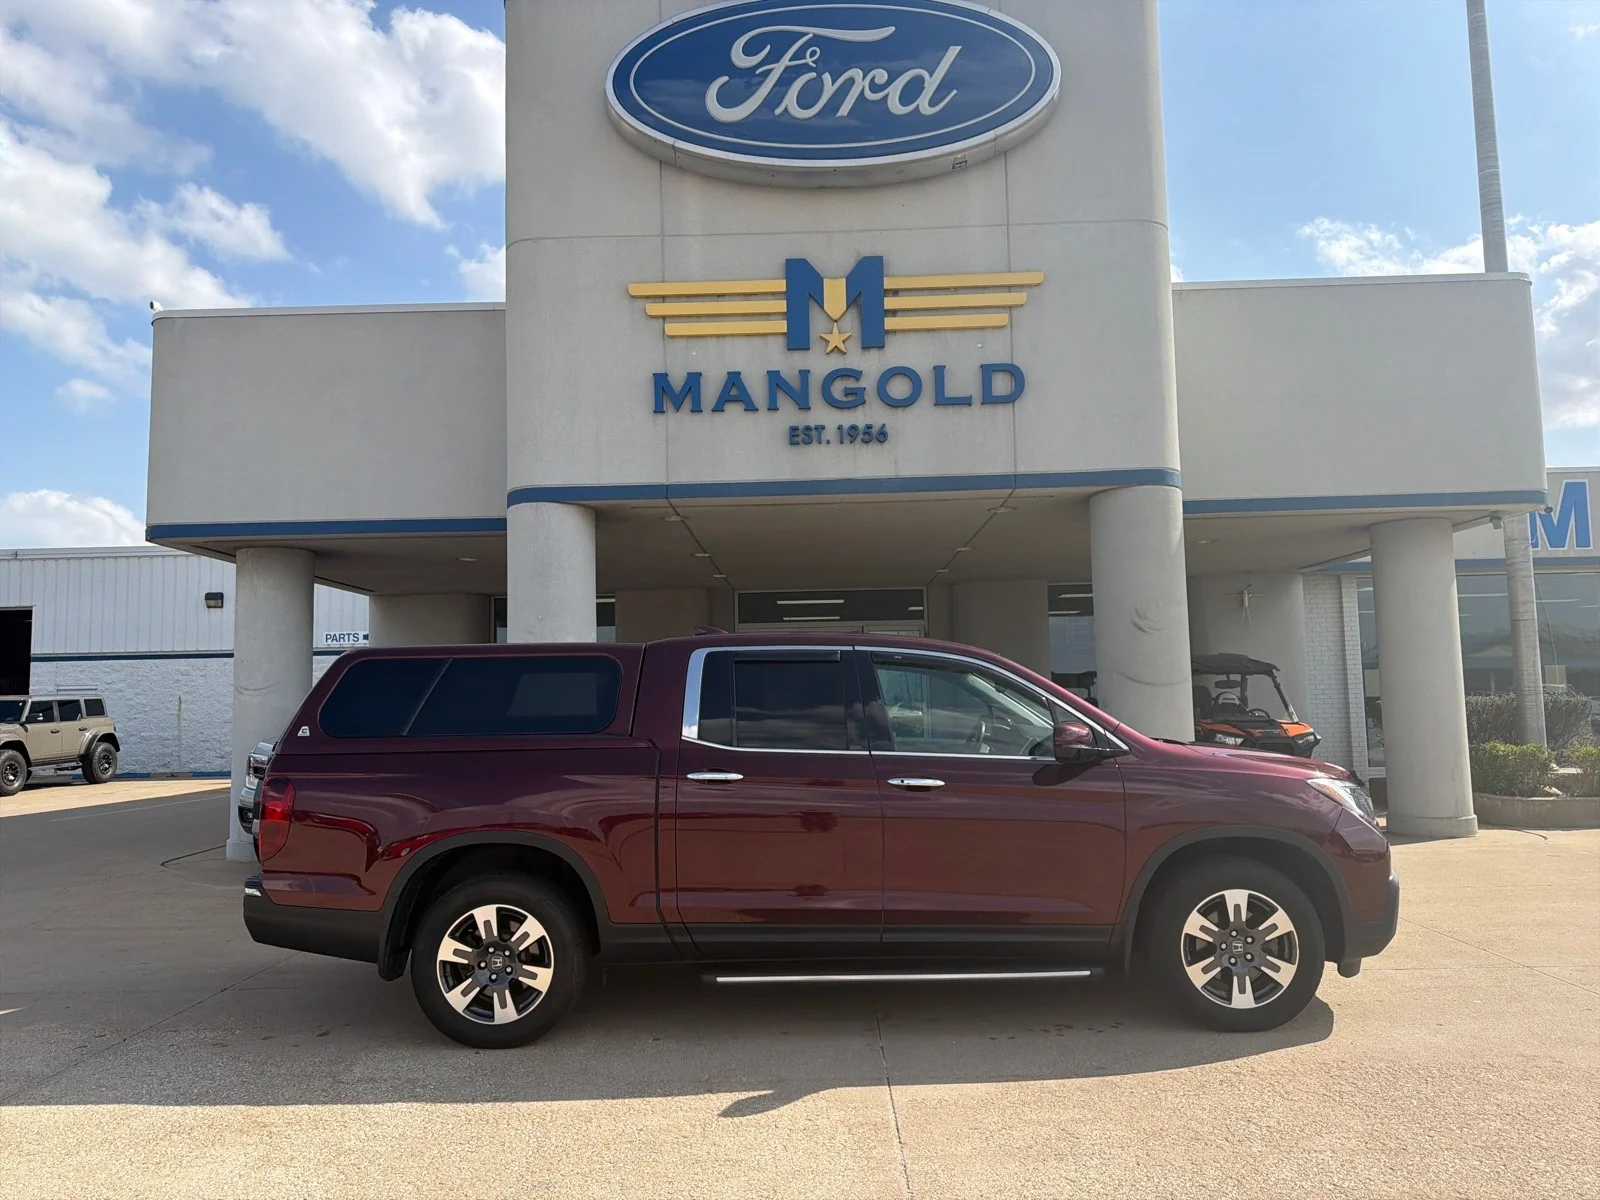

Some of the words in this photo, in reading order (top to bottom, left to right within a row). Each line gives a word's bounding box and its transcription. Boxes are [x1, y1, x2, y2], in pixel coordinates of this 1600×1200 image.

[705, 25, 962, 123] Ford
[652, 363, 1026, 414] MANGOLD
[788, 424, 831, 446] EST.
[837, 423, 889, 445] 1956
[325, 632, 360, 643] PARTS
